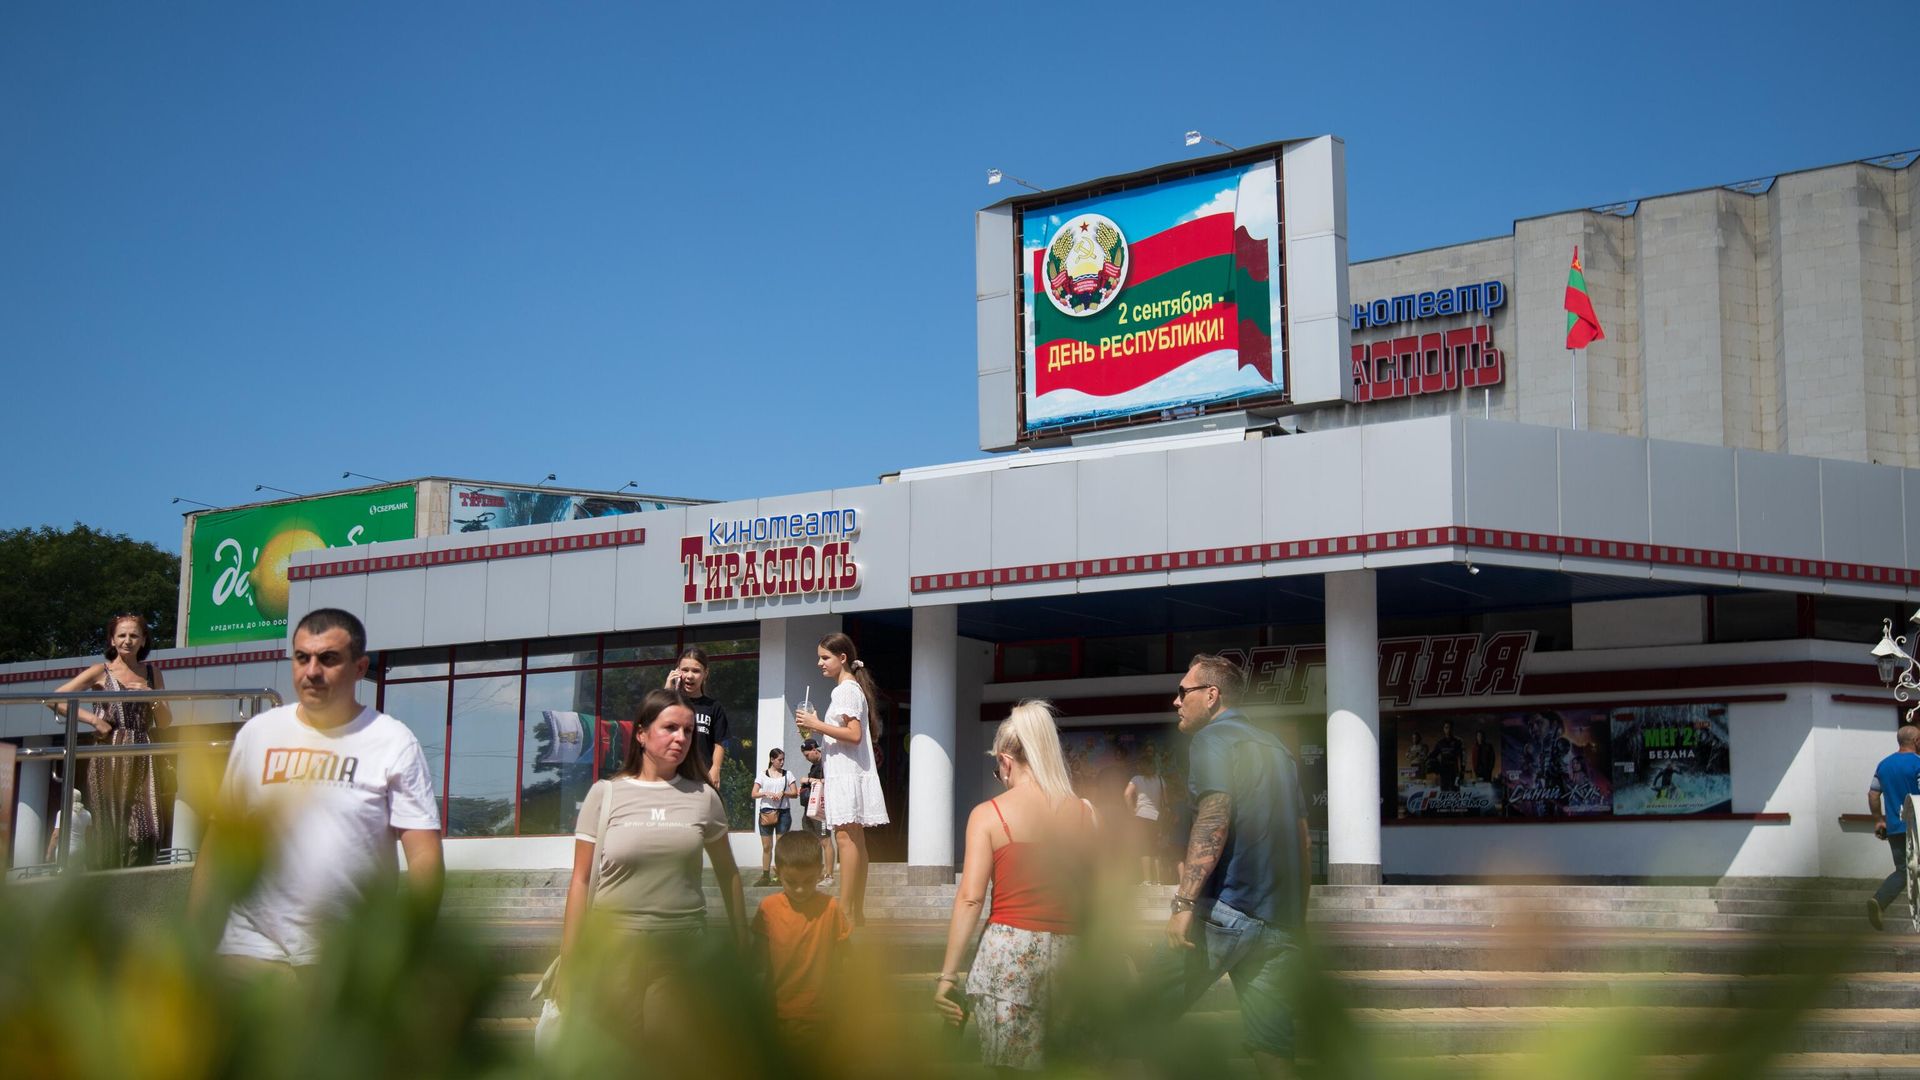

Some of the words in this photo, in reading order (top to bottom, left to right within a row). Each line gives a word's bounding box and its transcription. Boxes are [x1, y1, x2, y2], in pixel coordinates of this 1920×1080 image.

[1118, 302, 1128, 325] 2
[1132, 290, 1213, 323] сентября
[1350, 280, 1504, 330] нотеатр
[1047, 340, 1096, 372] ДЕНЬ
[1100, 317, 1225, 360] РЕСПУБЛИКИ!
[1351, 323, 1503, 403] АСПОЛЬ
[377, 502, 409, 513] СБЕРБАНК
[210, 624, 244, 632] КРЕДИТКА
[246, 622, 256, 630] ДО
[1216, 630, 1535, 708] ЕГДНЯ
[1643, 727, 1679, 748] МЕГ
[1648, 749, 1696, 759] БЕЗДНА
[264, 749, 359, 783] PUMA
[650, 807, 667, 821] M
